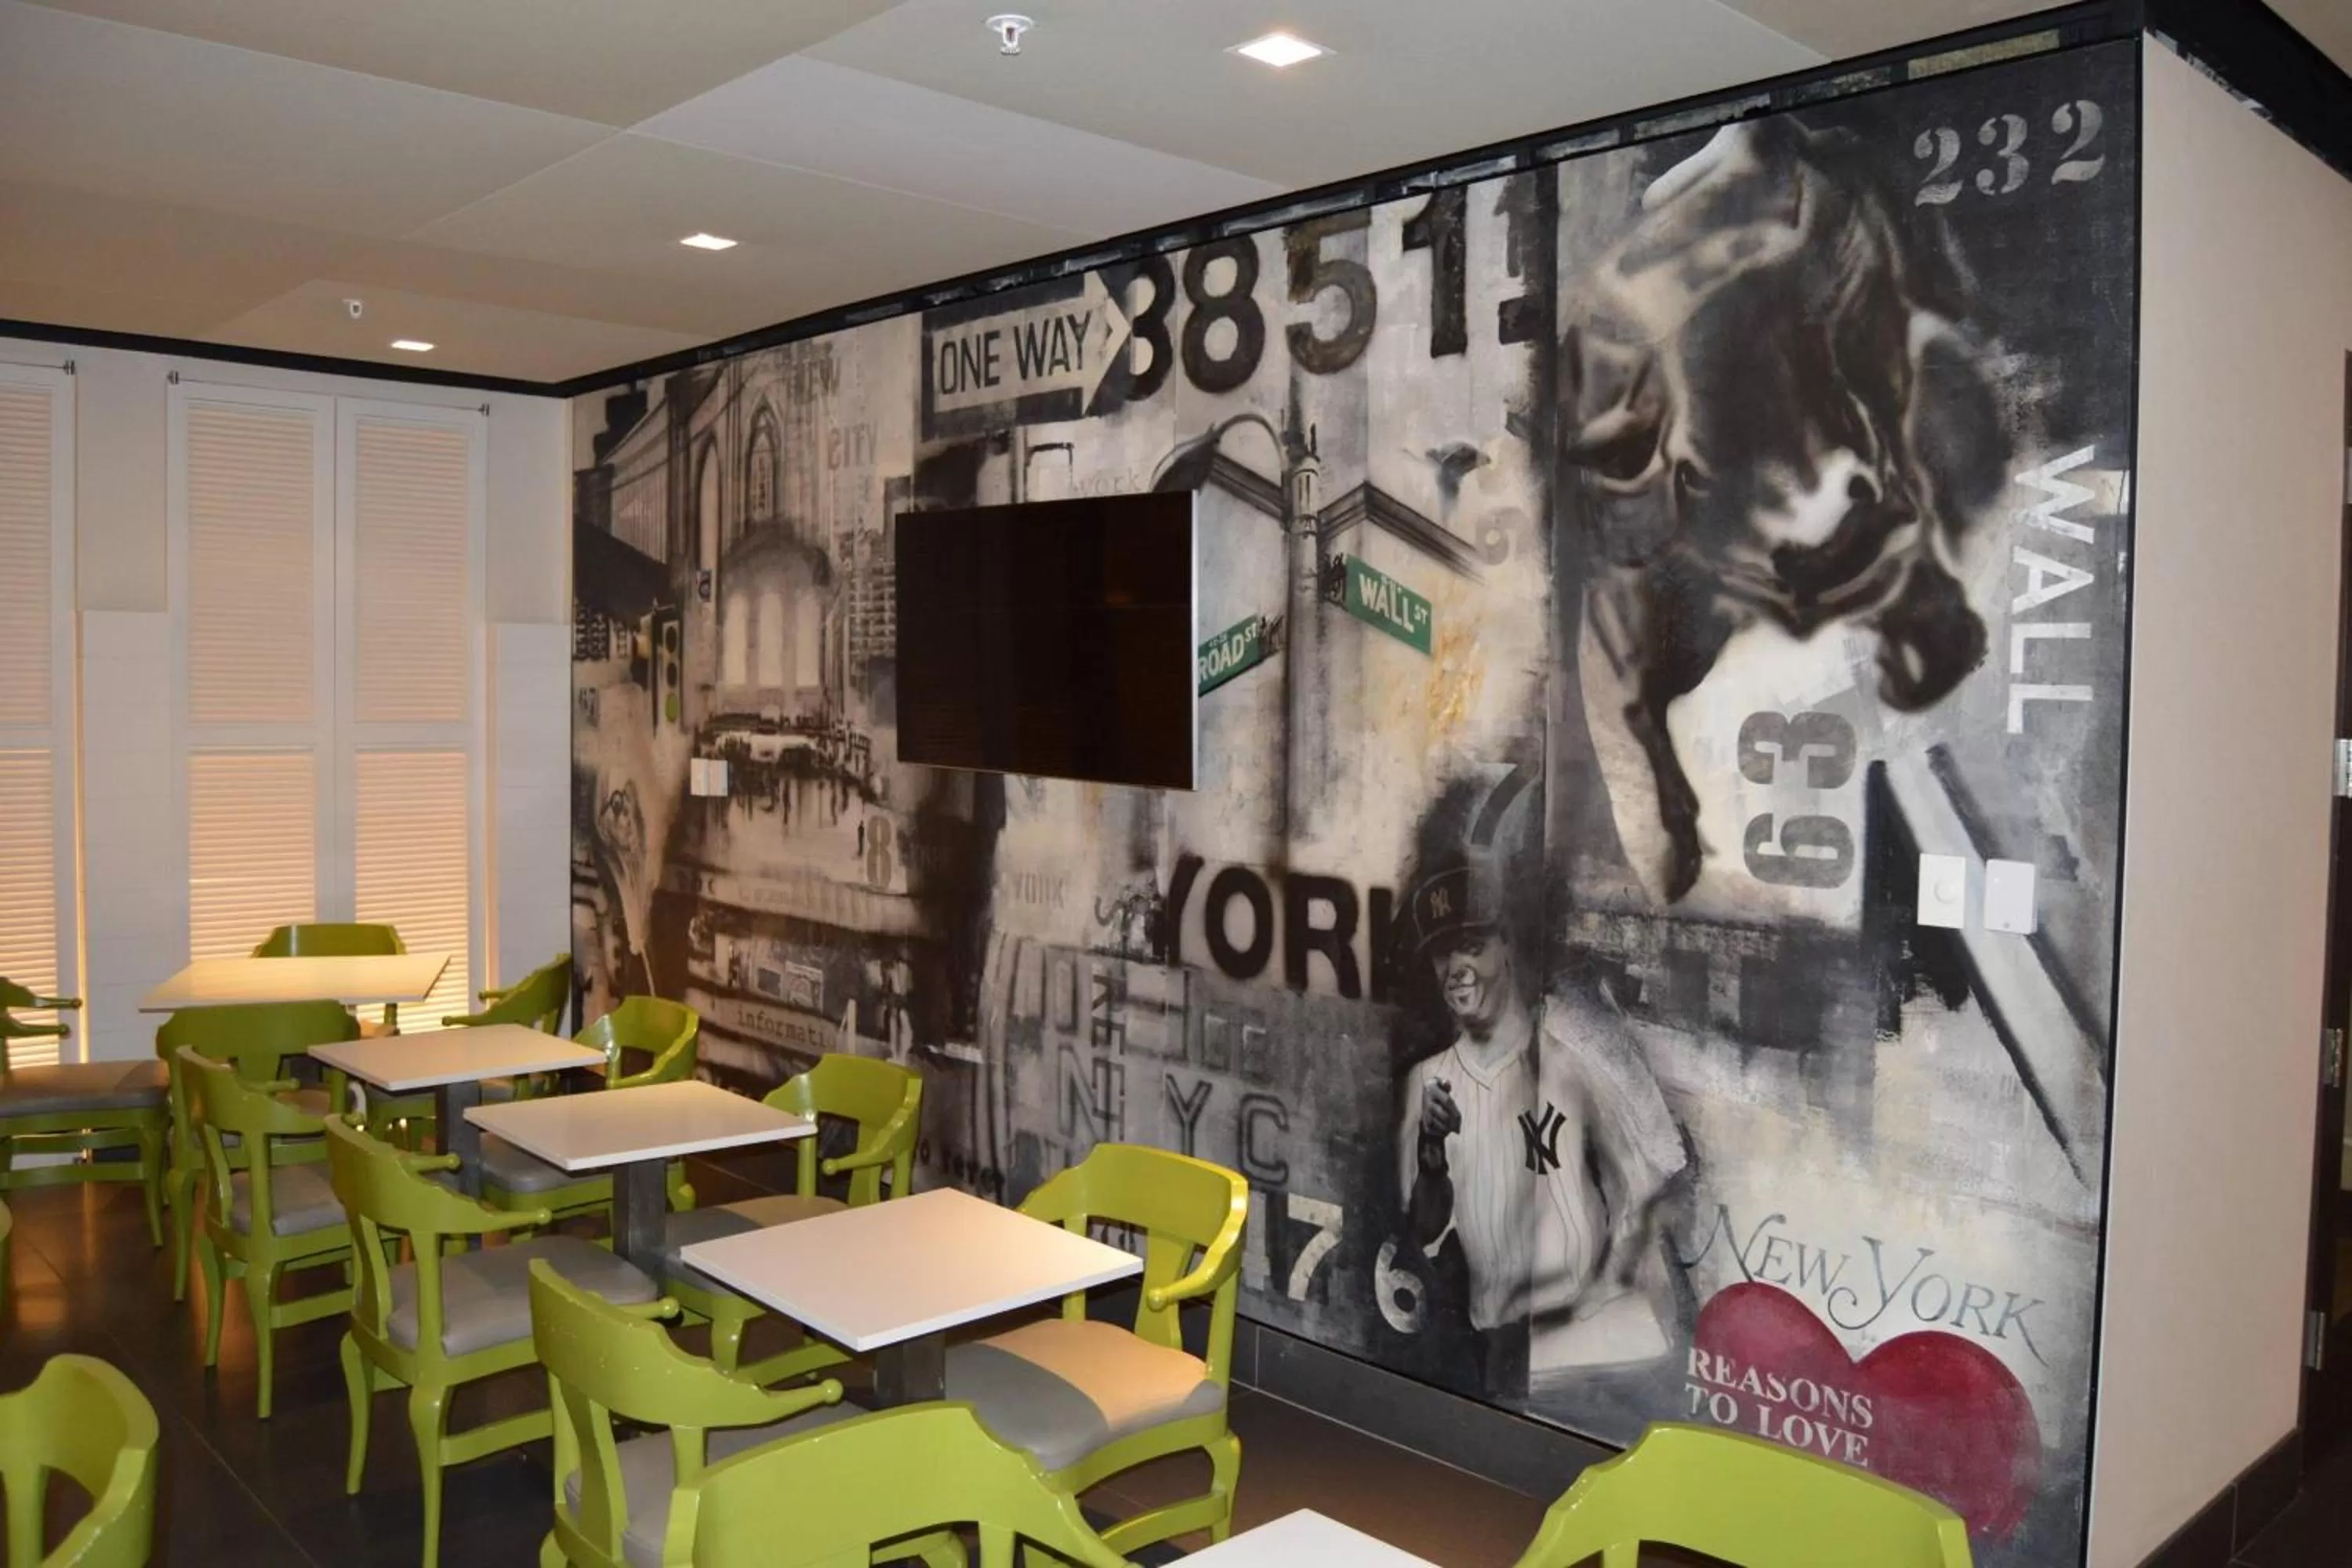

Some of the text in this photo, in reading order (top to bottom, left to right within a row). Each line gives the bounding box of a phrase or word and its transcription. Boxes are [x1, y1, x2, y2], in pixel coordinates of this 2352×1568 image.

[1914, 100, 2105, 206] 232
[942, 310, 1092, 395] ONE WAY
[1245, 622, 1257, 641] ST
[1358, 572, 1414, 633] WALL
[1414, 604, 1428, 626] ST
[2007, 445, 2095, 734] WALL
[1737, 710, 1857, 889] 63
[1680, 1203, 2048, 1367] NEW YORK
[1685, 1382, 1868, 1468] TO LOVE
[1687, 1348, 1874, 1429] REASONS
